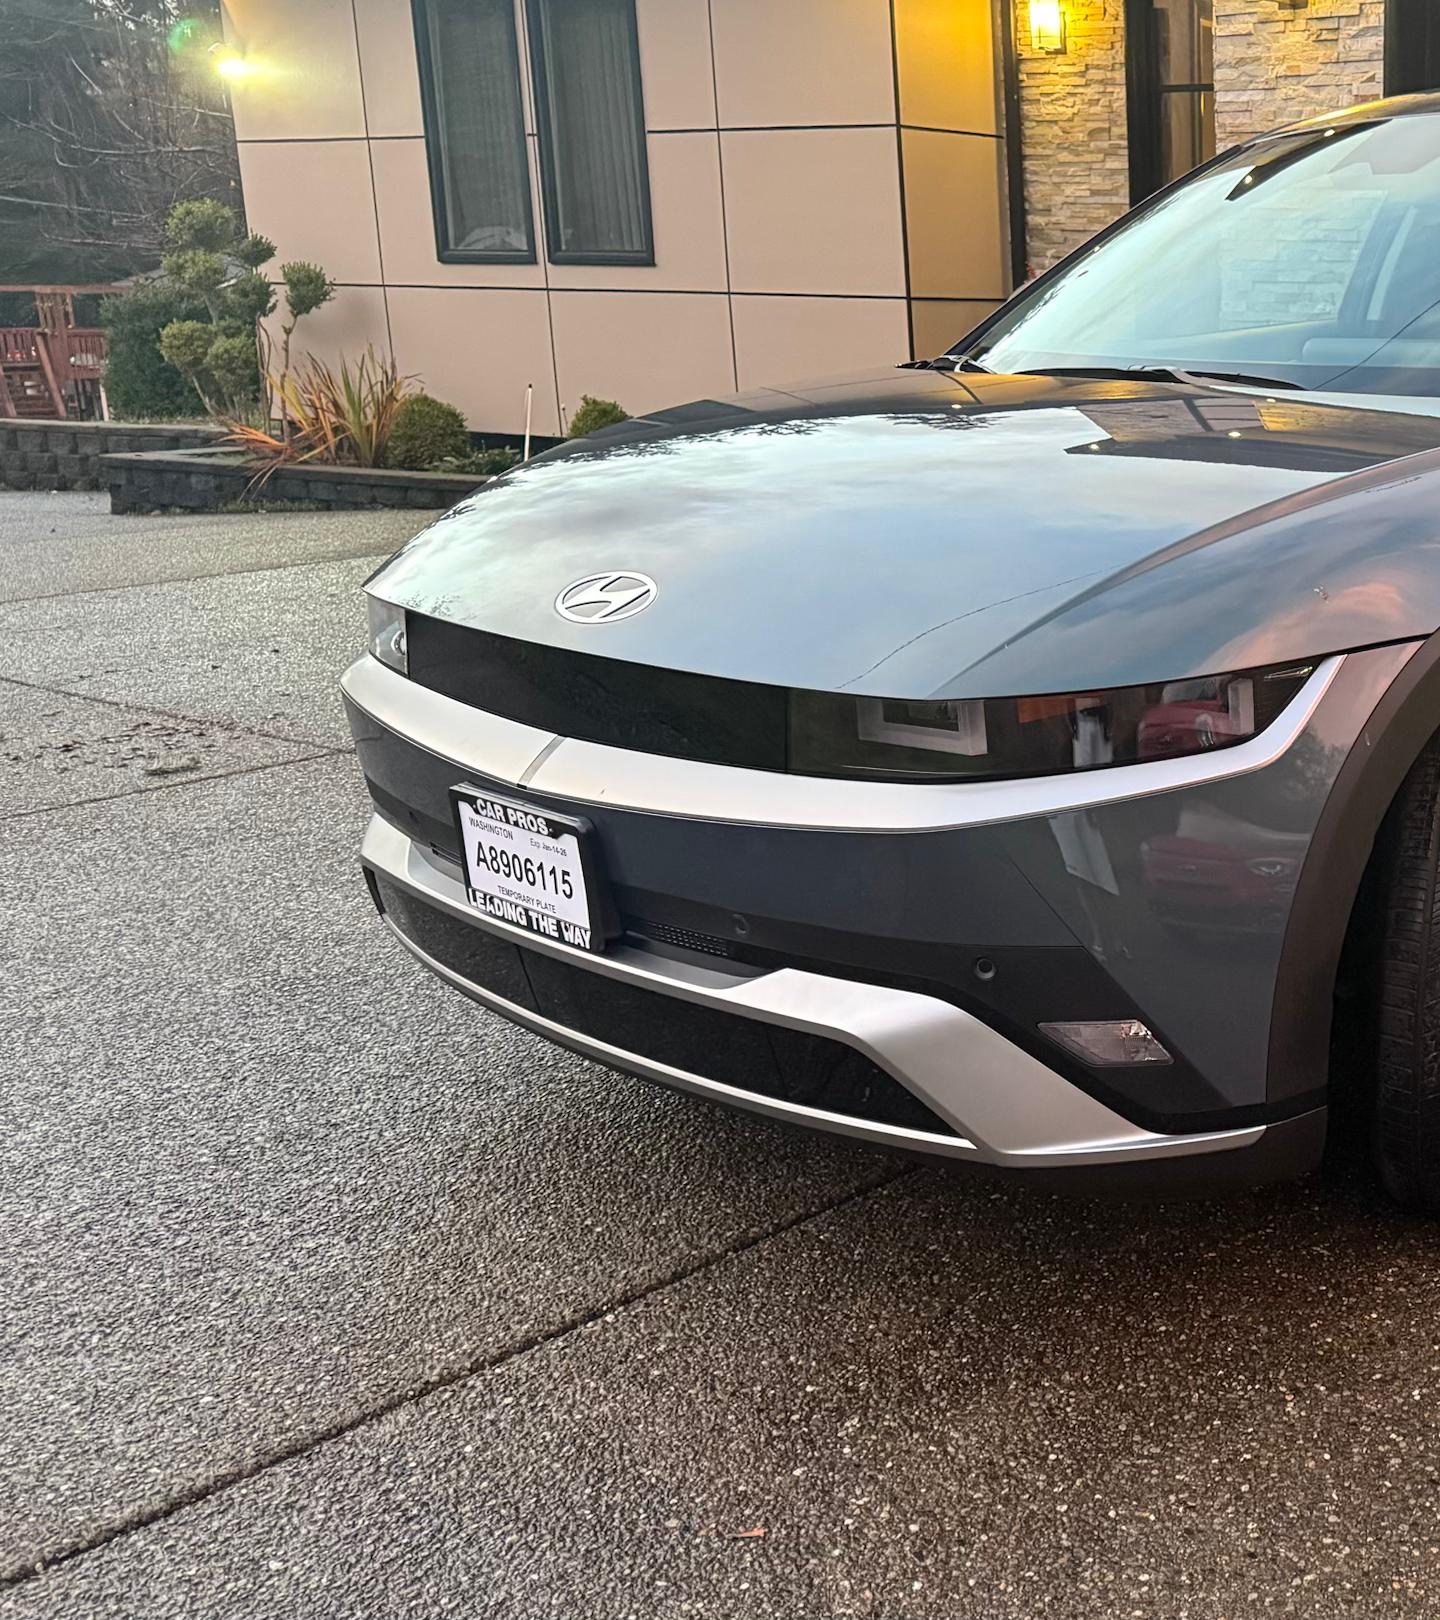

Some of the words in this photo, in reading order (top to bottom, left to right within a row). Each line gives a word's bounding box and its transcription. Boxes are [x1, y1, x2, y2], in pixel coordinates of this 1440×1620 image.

[468, 817, 514, 840] WASHINGTON
[476, 799, 504, 823] CAR
[507, 808, 549, 836] PROS
[476, 841, 573, 899] A8906115
[497, 885, 535, 906] TEMPORARY
[536, 896, 556, 914] PLATE
[468, 888, 527, 926] LEADING
[528, 911, 559, 937] THE
[560, 921, 591, 949] WAY
